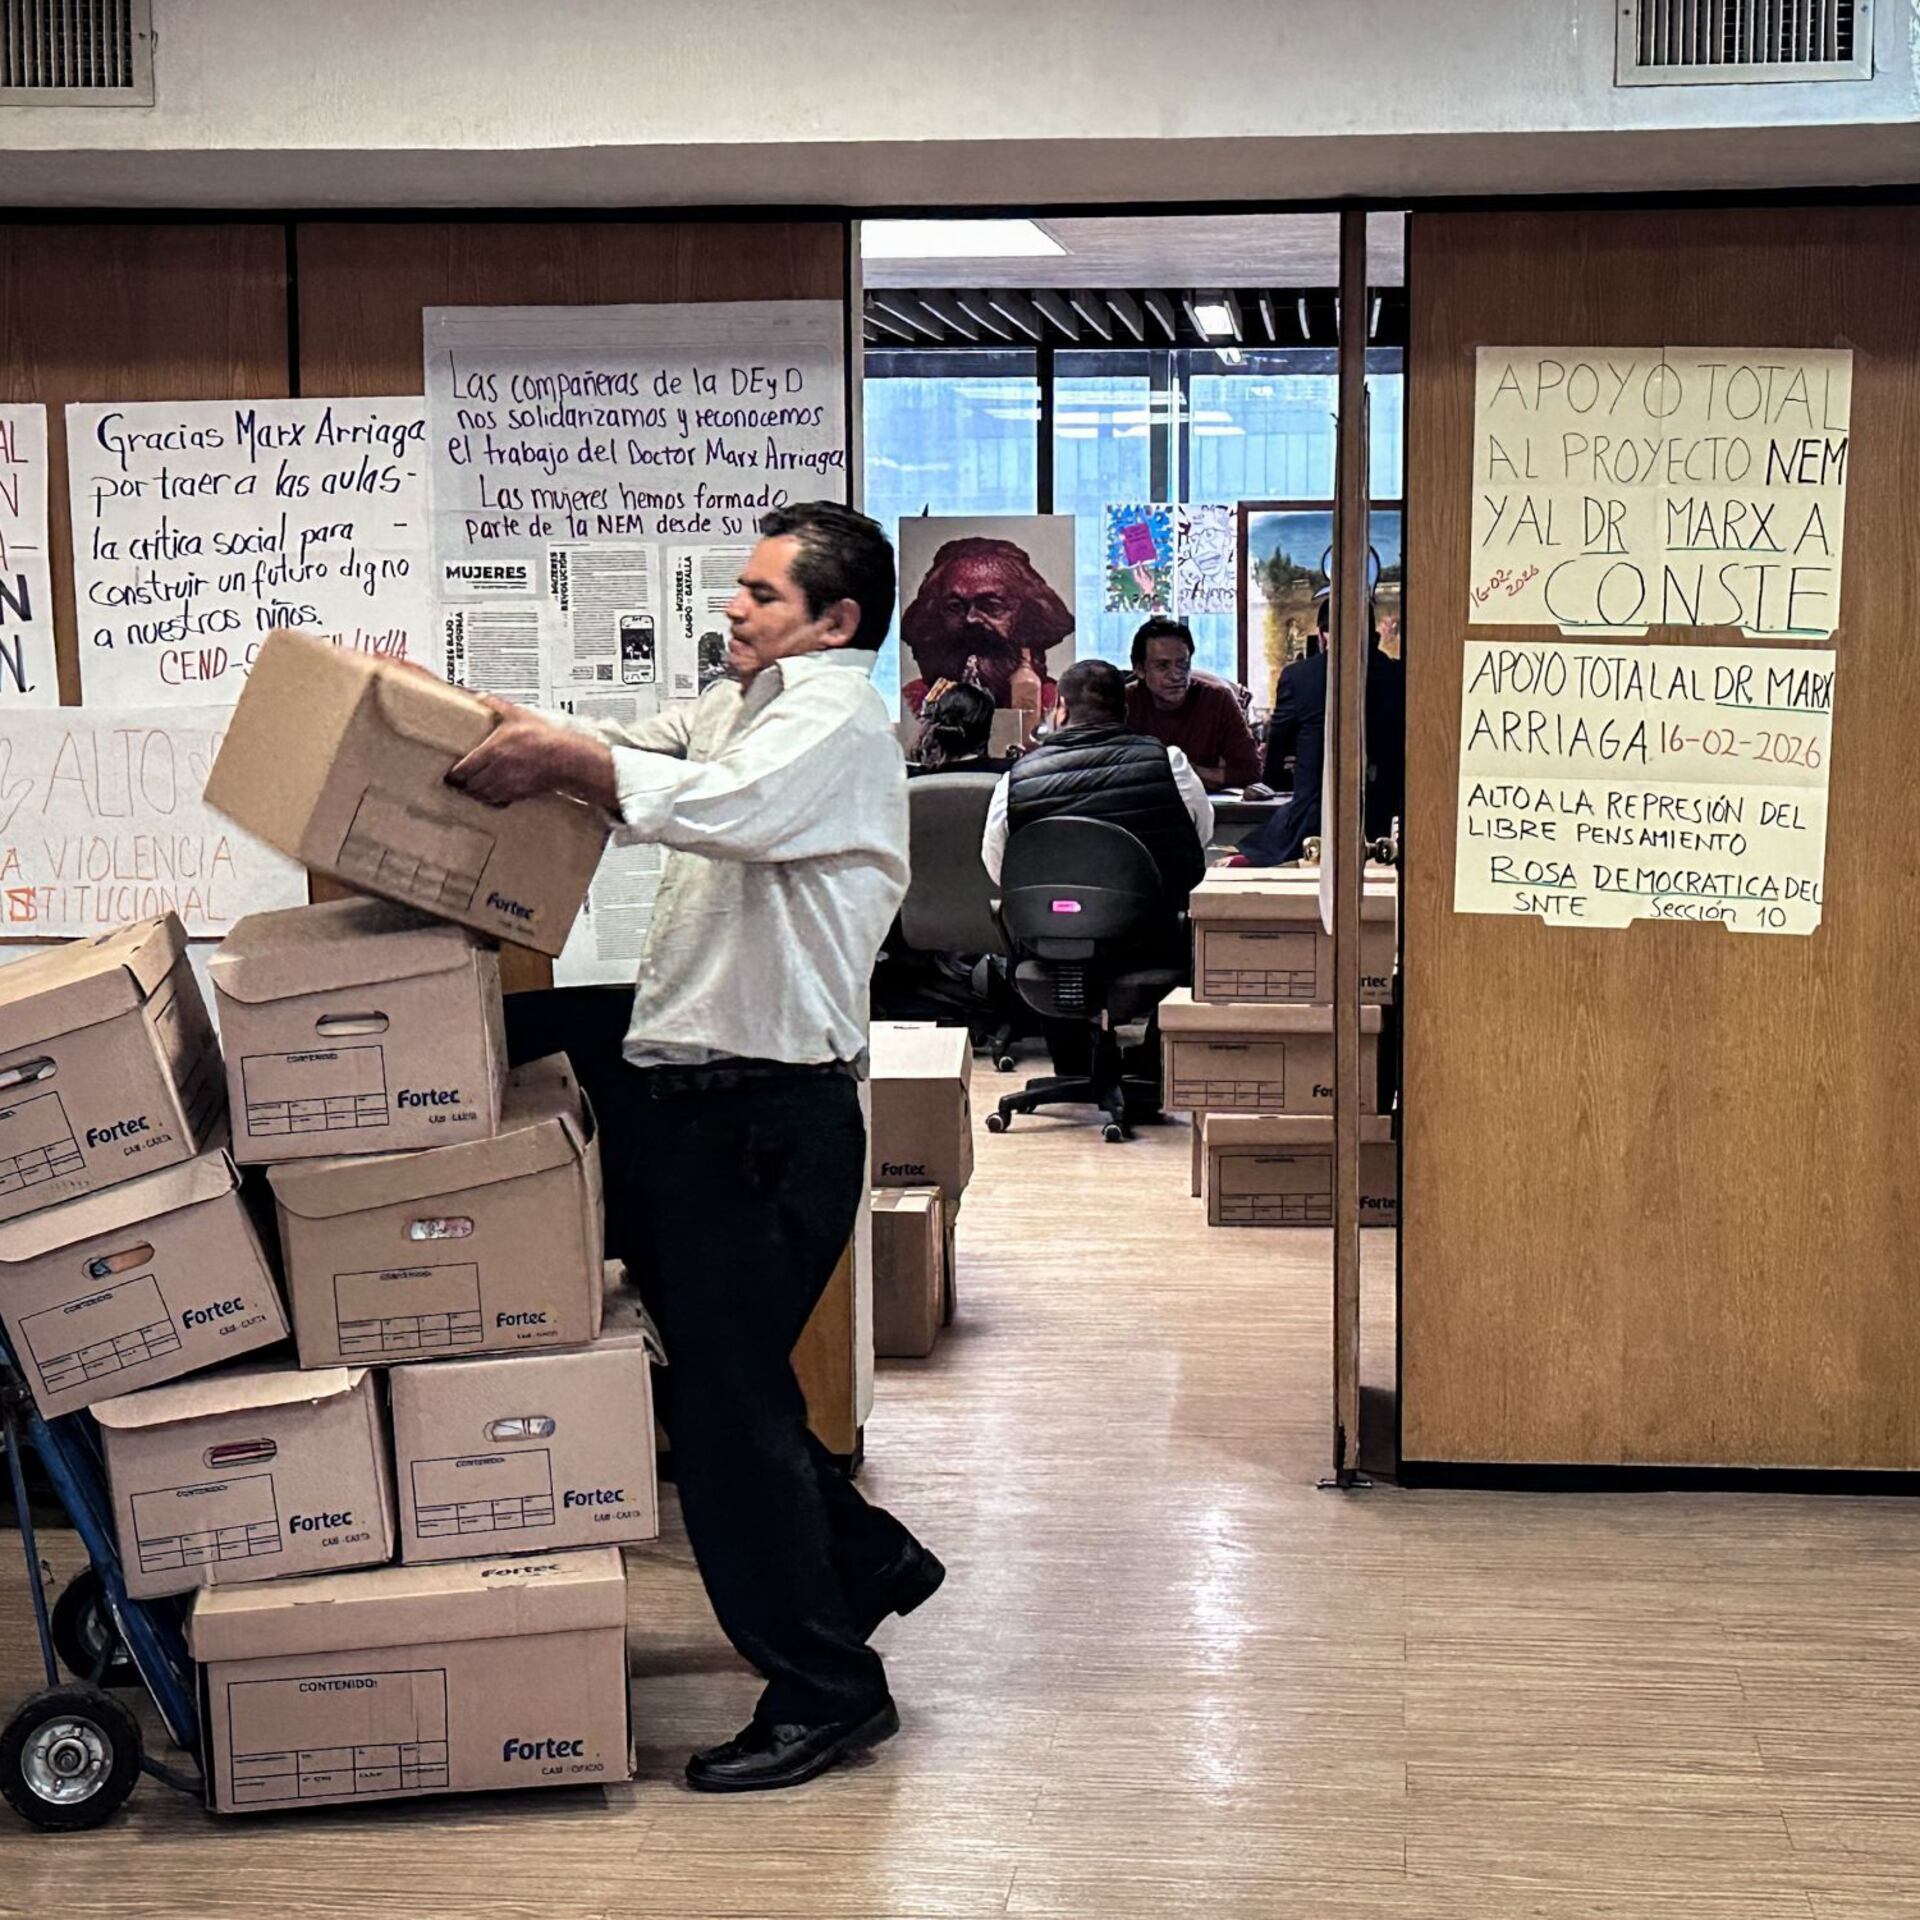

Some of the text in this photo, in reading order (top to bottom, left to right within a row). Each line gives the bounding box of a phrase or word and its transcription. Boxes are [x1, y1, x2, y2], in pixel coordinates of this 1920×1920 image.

[448, 349, 498, 404] Las
[511, 368, 640, 405] compañeras
[653, 369, 683, 396] de
[692, 367, 717, 396] la
[1489, 359, 1848, 432] APOYO TOTAL
[97, 406, 426, 471] Gracias Marx Arriaga
[457, 404, 824, 438] nos solidarizamos y reconocemos
[448, 434, 844, 475] el trabajo del Doctor Marx Arriaga
[1489, 432, 1849, 486] AL PROYECTO NEM
[88, 476, 149, 518] por
[152, 466, 232, 500] traer
[235, 475, 257, 495] a
[275, 458, 310, 498] las
[479, 475, 789, 519] Las mujeres hemos formado
[92, 526, 120, 560] la
[213, 512, 287, 555] social
[300, 523, 354, 565] para
[465, 515, 520, 545] parte
[529, 513, 553, 538] de
[567, 514, 588, 539] la
[597, 513, 644, 536] NEM
[656, 513, 712, 536] desde
[722, 514, 743, 535] su
[1583, 496, 1629, 550] DR
[1666, 497, 1777, 550] MARX
[89, 546, 410, 606] construir un futuro digno
[445, 565, 527, 580] MUJERES
[93, 628, 114, 649] a
[127, 598, 242, 645] nuestros
[1468, 650, 1835, 708] APOYO TOTAL AL DR MARX
[1467, 709, 1822, 769] ARRIAGA 16-02-2026
[42, 729, 177, 818] ALTO
[1467, 782, 1531, 810] ALTO
[1559, 789, 1596, 816] LA
[1606, 791, 1745, 825] REPRESIÓN
[1760, 800, 1807, 830] DEL
[1467, 816, 1748, 856] LIBRE PENSAMIENTO
[42, 835, 238, 881] VIOLENCIA
[1490, 855, 1824, 906] ROSA DEMOCRATICA DEL
[486, 892, 536, 920] Fortec
[1513, 891, 1588, 917] SNTE
[1756, 906, 1786, 928] 10
[1361, 975, 1388, 988] rtec
[397, 1088, 460, 1109] Fortec
[86, 1115, 150, 1149] Fortec
[880, 1162, 926, 1177] Fortec
[181, 1297, 245, 1330] Fortec
[496, 1311, 547, 1328] Fortec
[563, 1488, 625, 1509] Fortec
[289, 1511, 353, 1535] Fortec
[503, 1738, 584, 1762] Fortec
